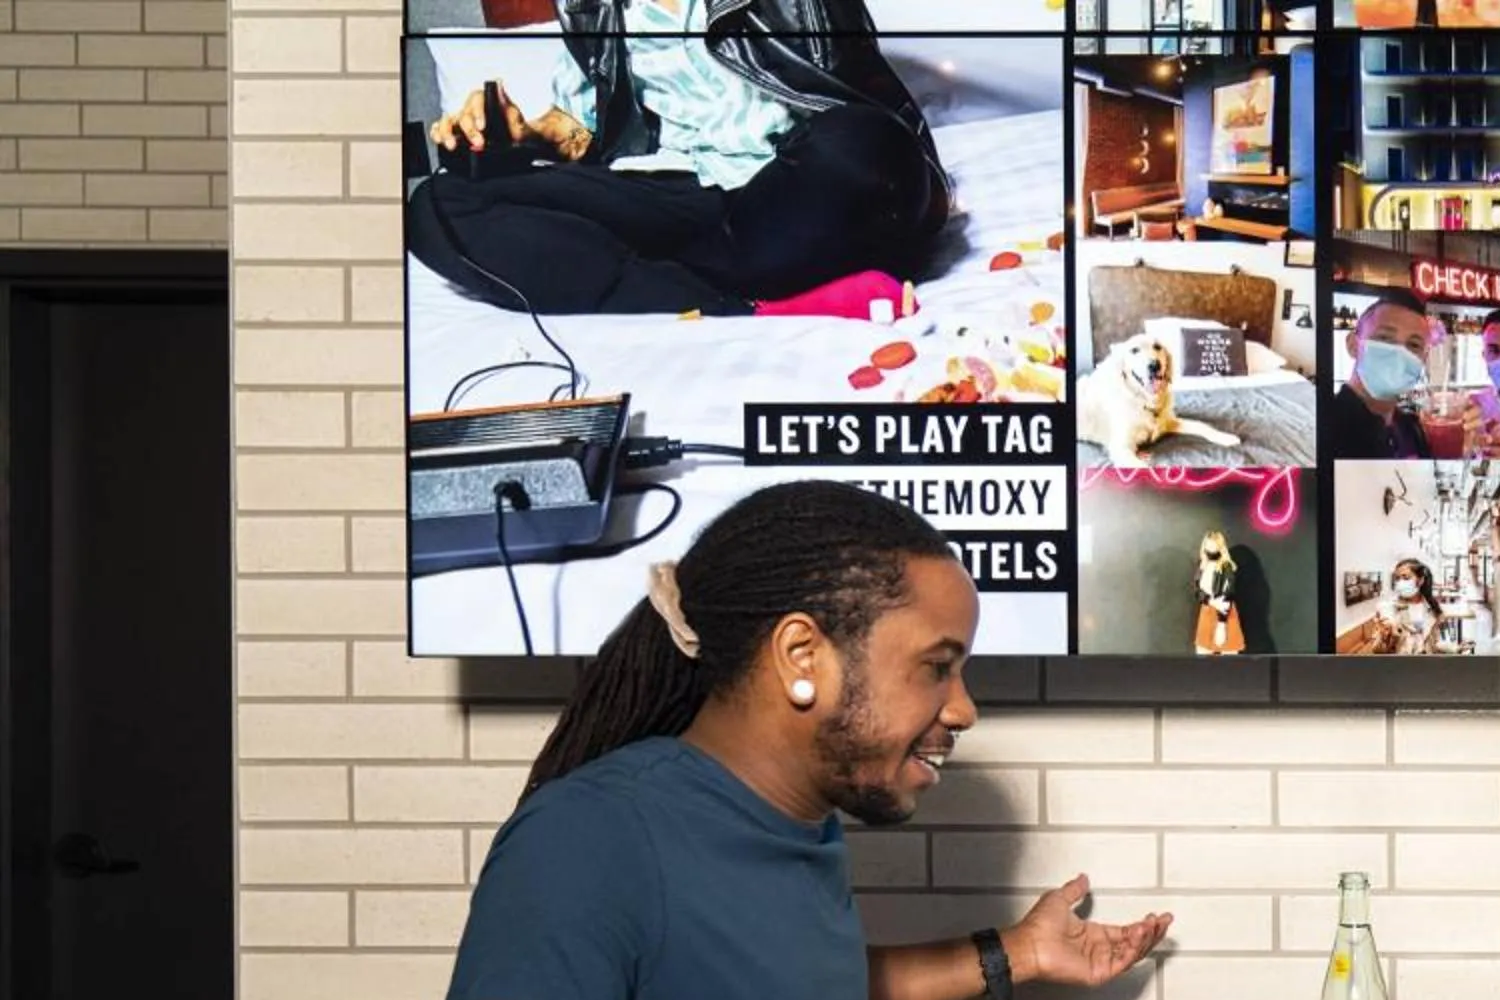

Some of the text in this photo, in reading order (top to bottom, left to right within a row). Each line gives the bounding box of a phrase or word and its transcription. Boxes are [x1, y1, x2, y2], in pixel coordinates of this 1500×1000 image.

[1417, 261, 1490, 299] CHECK
[757, 415, 1053, 454] LET'S PLAY TAG
